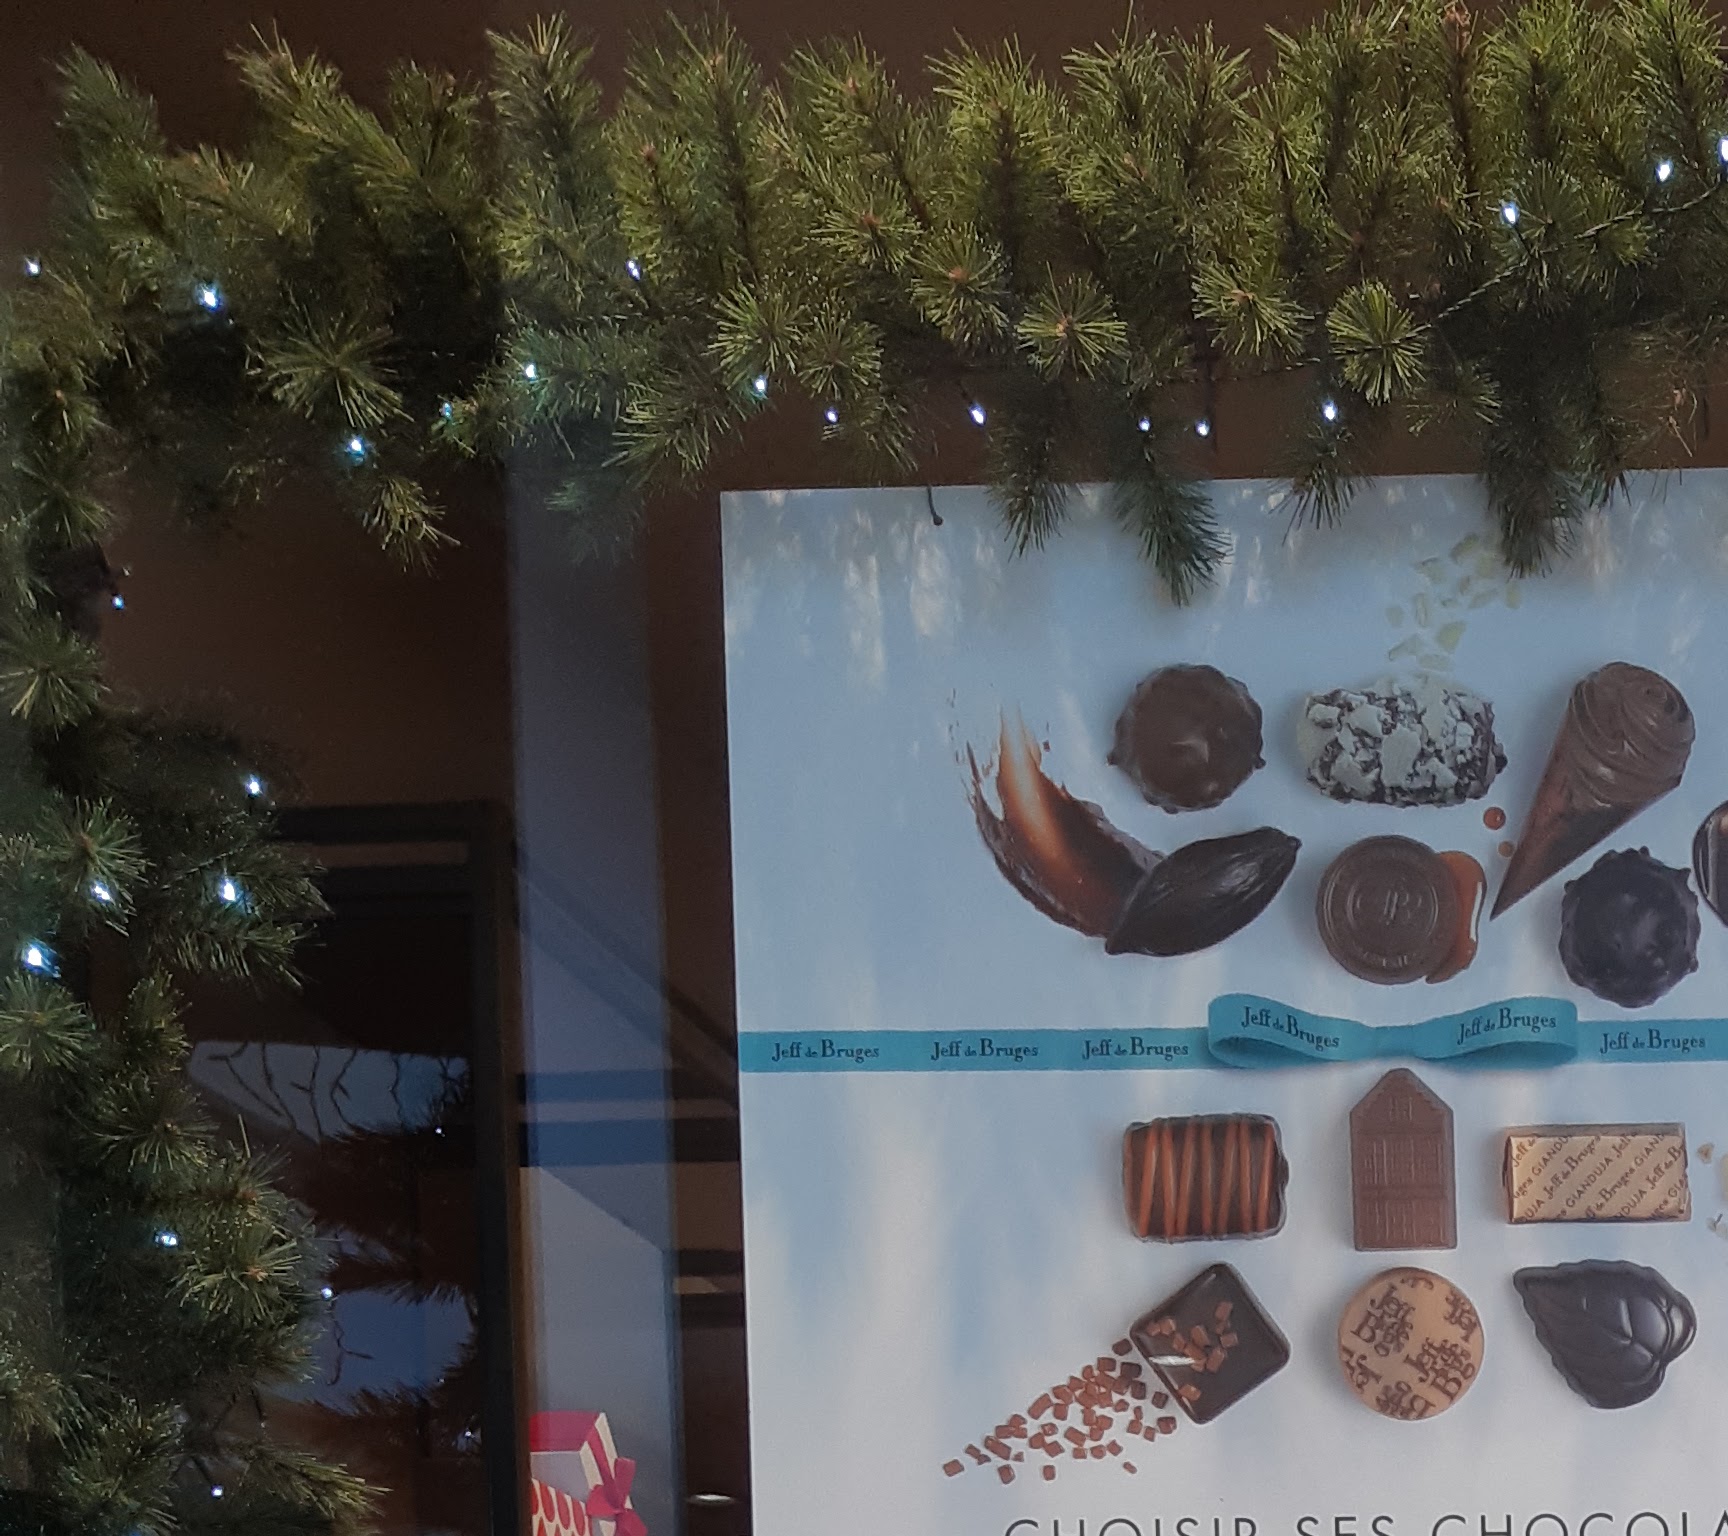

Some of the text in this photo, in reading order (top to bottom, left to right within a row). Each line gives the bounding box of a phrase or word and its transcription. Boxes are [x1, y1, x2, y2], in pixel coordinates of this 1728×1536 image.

[1241, 1006, 1270, 1027] Jeff
[1286, 1014, 1340, 1051] Bruges
[1457, 1020, 1482, 1045] Jeff
[1498, 1007, 1556, 1034] Bruges
[772, 1041, 800, 1061] Jeff
[821, 1039, 879, 1063] Bruges
[931, 1041, 961, 1059] Jeff
[980, 1038, 1039, 1062] Bruges
[1082, 1039, 1111, 1059] Jeff
[1130, 1037, 1188, 1061] Bruges
[1601, 1033, 1629, 1054] Jeff
[1646, 1029, 1705, 1055] Bruges
